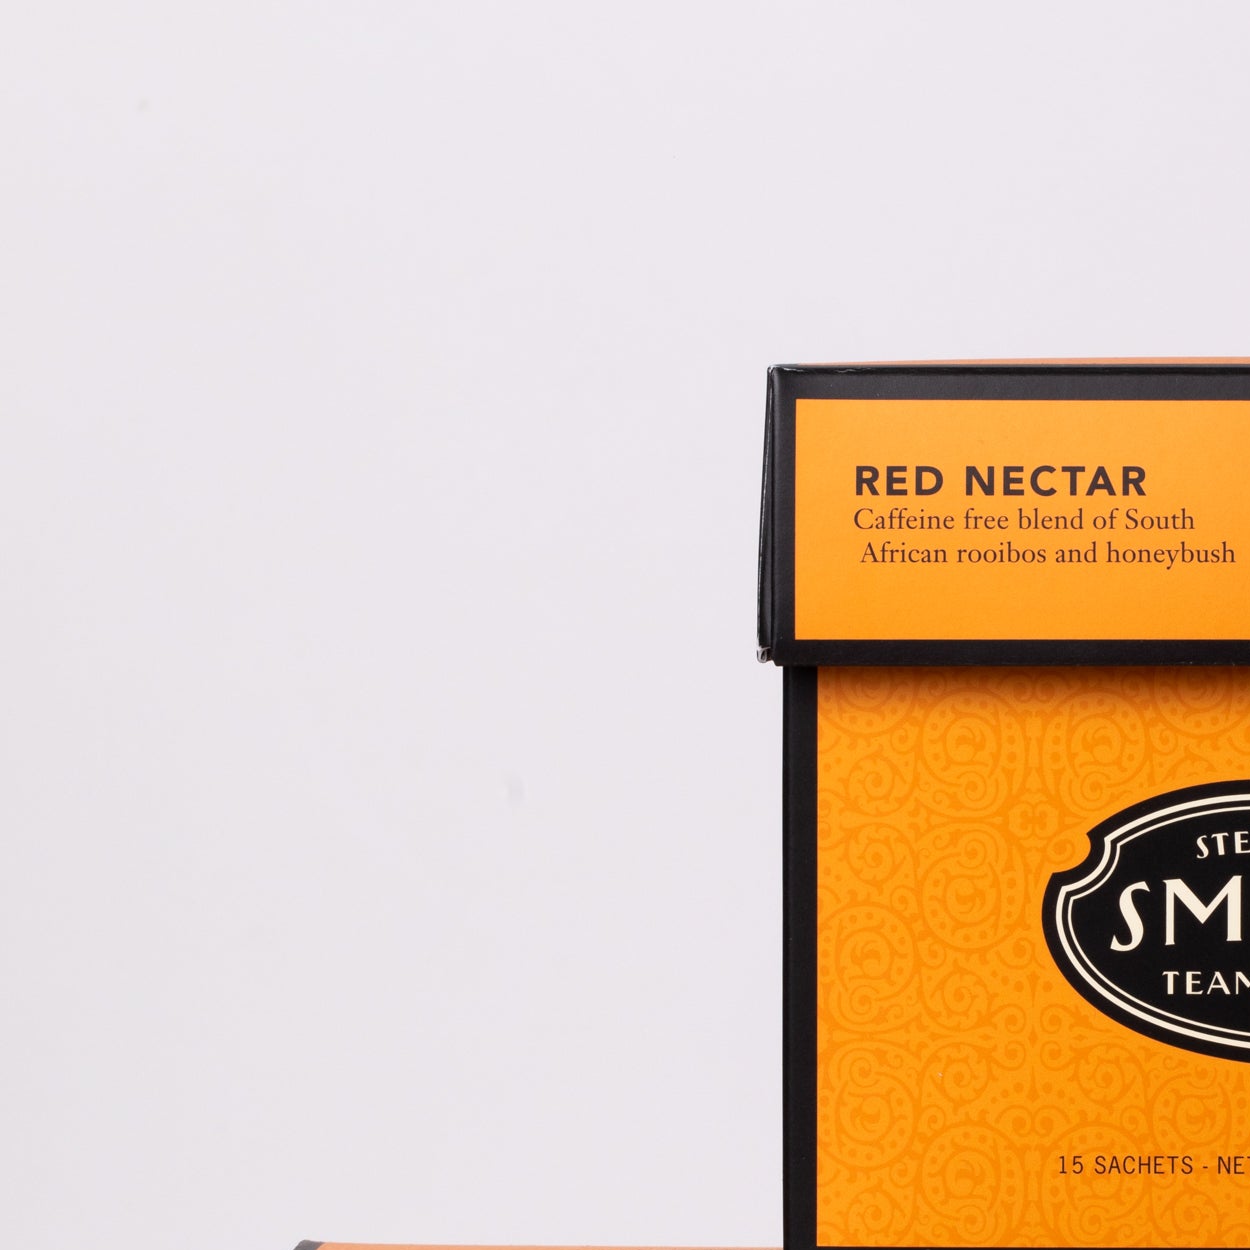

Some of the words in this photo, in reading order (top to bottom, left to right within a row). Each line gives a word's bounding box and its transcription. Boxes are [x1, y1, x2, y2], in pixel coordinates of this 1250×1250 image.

[855, 465, 944, 497] RED
[965, 464, 1147, 497] NECTAR
[853, 507, 955, 530] Caffeine
[963, 507, 1009, 530] free
[1017, 507, 1084, 530] blend
[1092, 507, 1120, 530] of
[1125, 507, 1195, 530] South
[860, 540, 948, 563] African
[957, 540, 1047, 563] rooibos
[1055, 540, 1098, 564] and
[1106, 540, 1236, 571] honeybush
[1059, 1155, 1084, 1175] 15
[1094, 1155, 1194, 1175] SACHETS
